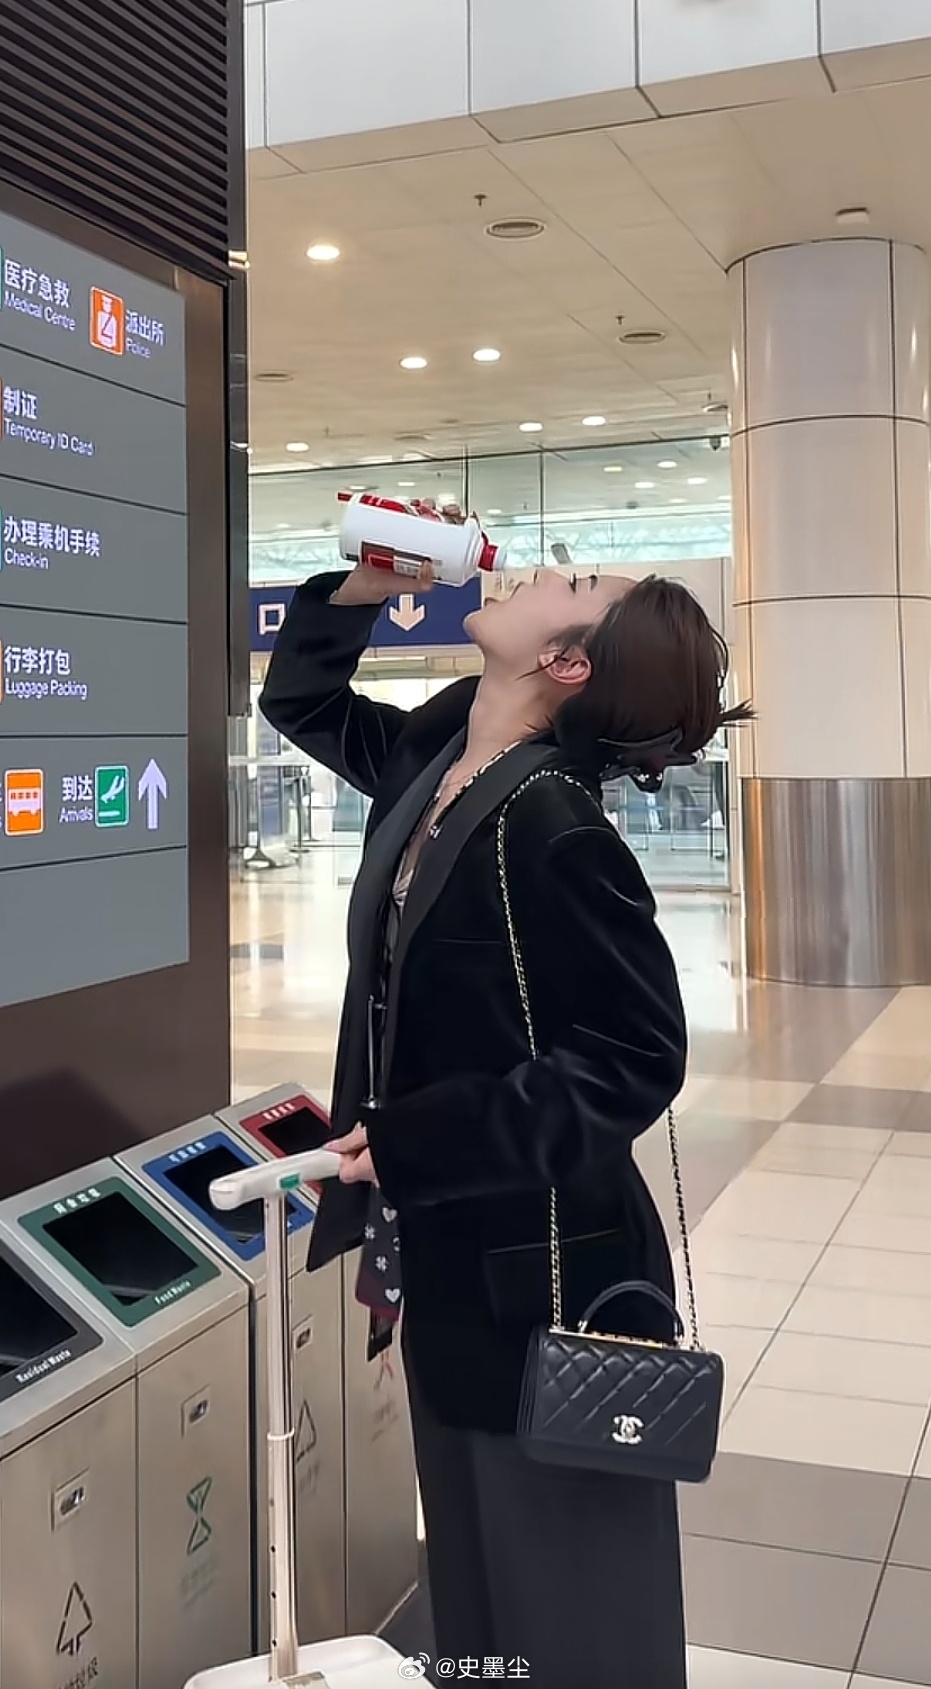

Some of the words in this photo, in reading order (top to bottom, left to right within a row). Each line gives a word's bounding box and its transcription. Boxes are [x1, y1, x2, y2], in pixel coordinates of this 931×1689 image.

[4, 259, 70, 309] 医疗急救
[4, 290, 43, 319] Medical
[43, 306, 76, 332] Centre
[124, 309, 165, 347] 派出所
[3, 385, 38, 420] 制证
[3, 417, 56, 450] Temporary
[57, 432, 69, 450] ID
[70, 436, 95, 457] Card
[3, 515, 101, 557] 办理乘机手续
[4, 547, 49, 570] Check-in
[4, 645, 71, 676] 行李打包
[4, 677, 49, 700] Luggage
[50, 678, 87, 701] Packing
[61, 774, 94, 802] 到达
